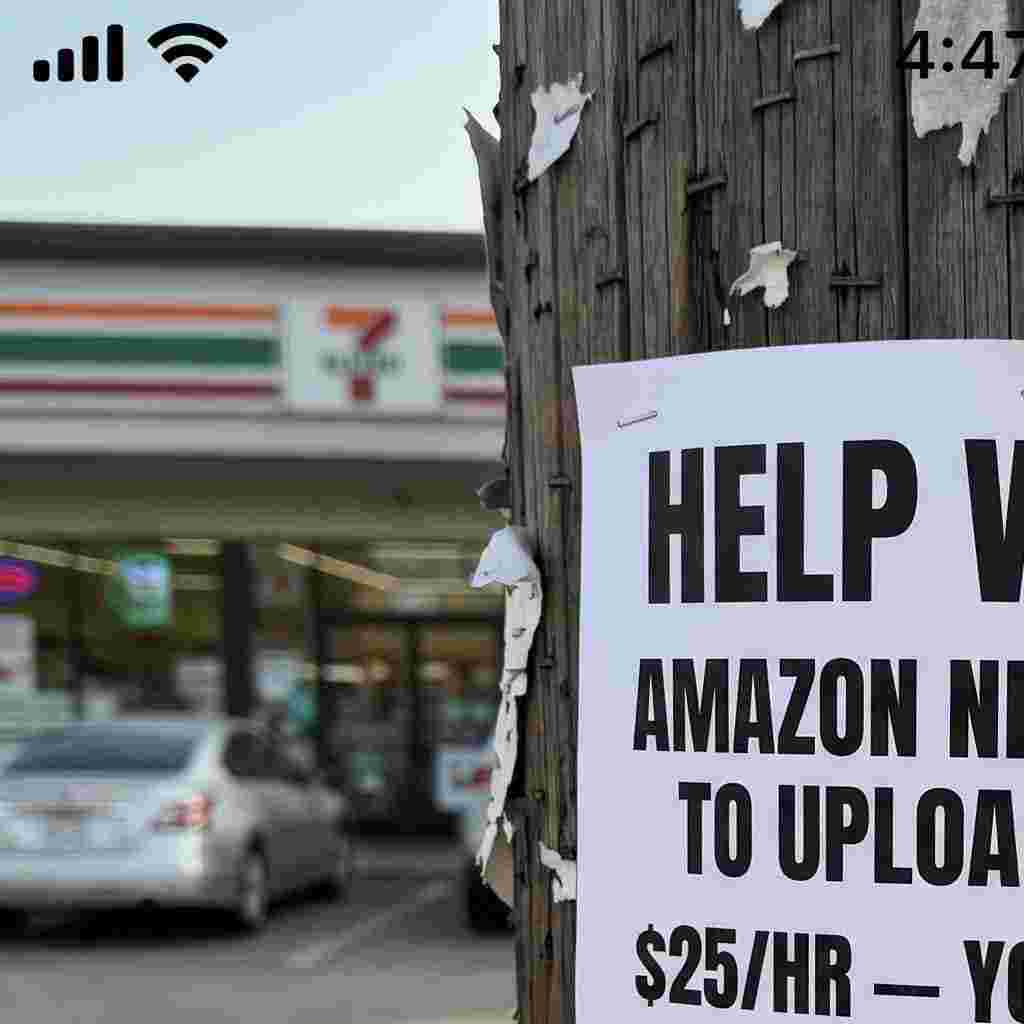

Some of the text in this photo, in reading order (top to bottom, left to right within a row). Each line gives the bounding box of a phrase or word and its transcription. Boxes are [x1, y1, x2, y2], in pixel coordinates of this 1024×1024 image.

[648, 440, 917, 604] HELP
[633, 658, 918, 758] AMAZON
[678, 782, 753, 878] TO
[635, 924, 852, 1018] $25/HR
